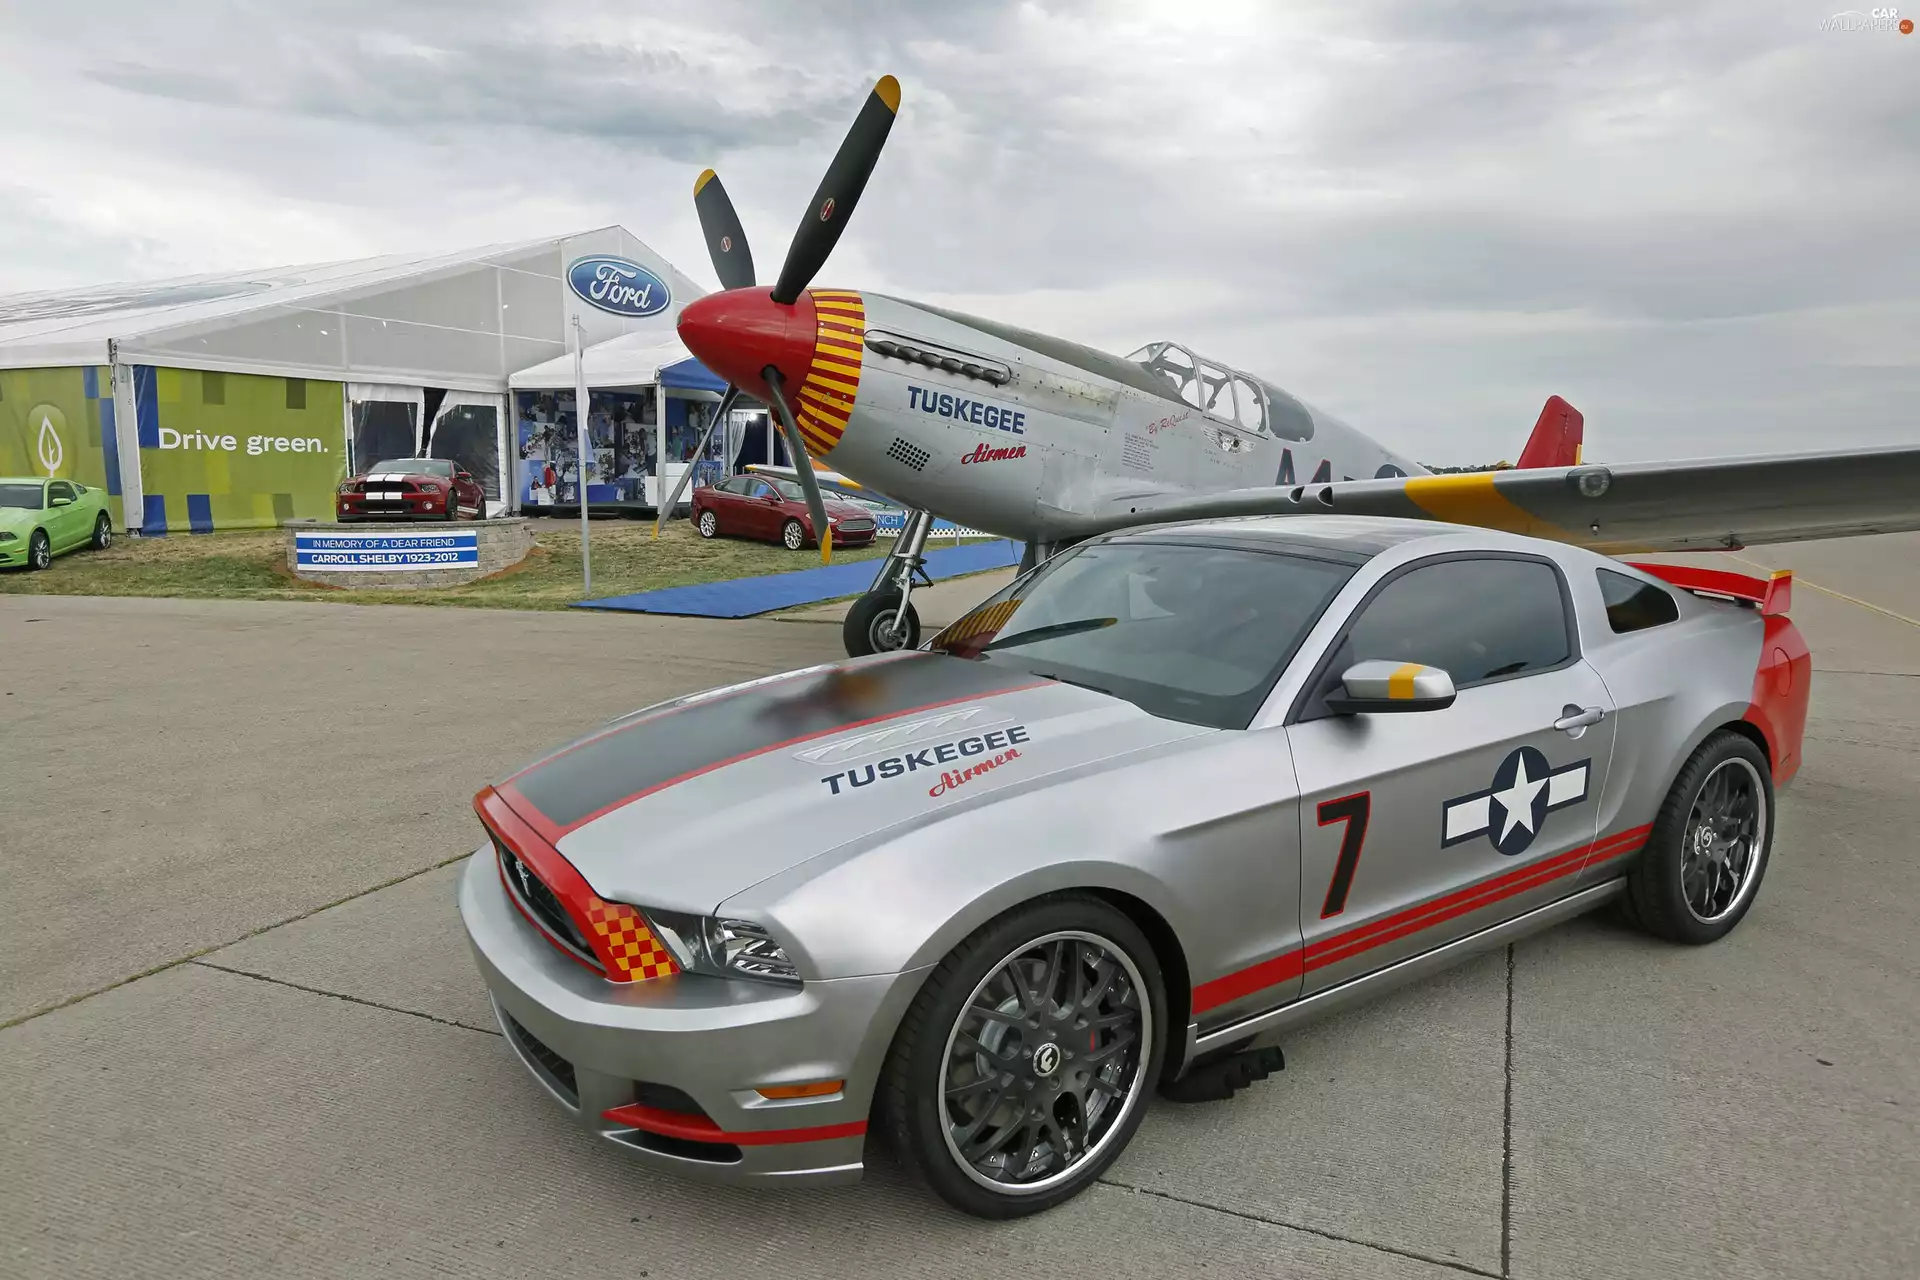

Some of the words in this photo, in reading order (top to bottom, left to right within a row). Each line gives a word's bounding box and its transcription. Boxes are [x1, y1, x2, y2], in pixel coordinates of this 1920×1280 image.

[589, 263, 652, 309] Ford
[907, 385, 1026, 435] TUSKEGEE
[158, 427, 237, 451] Drive
[246, 434, 329, 456] green.
[961, 442, 1027, 465] Airmen
[311, 554, 358, 564] CARROLL
[359, 553, 404, 564] SHELBY
[405, 552, 459, 563] 1923-2012
[312, 539, 322, 548] IN
[323, 539, 363, 548] MEMORY
[365, 539, 380, 548] OF
[382, 539, 388, 548] A
[391, 539, 418, 548] DEAR
[420, 538, 455, 547] FRIEND
[821, 725, 1031, 795] TUSKEGEE
[928, 747, 1023, 798] Airmen
[1316, 790, 1371, 920] 7
